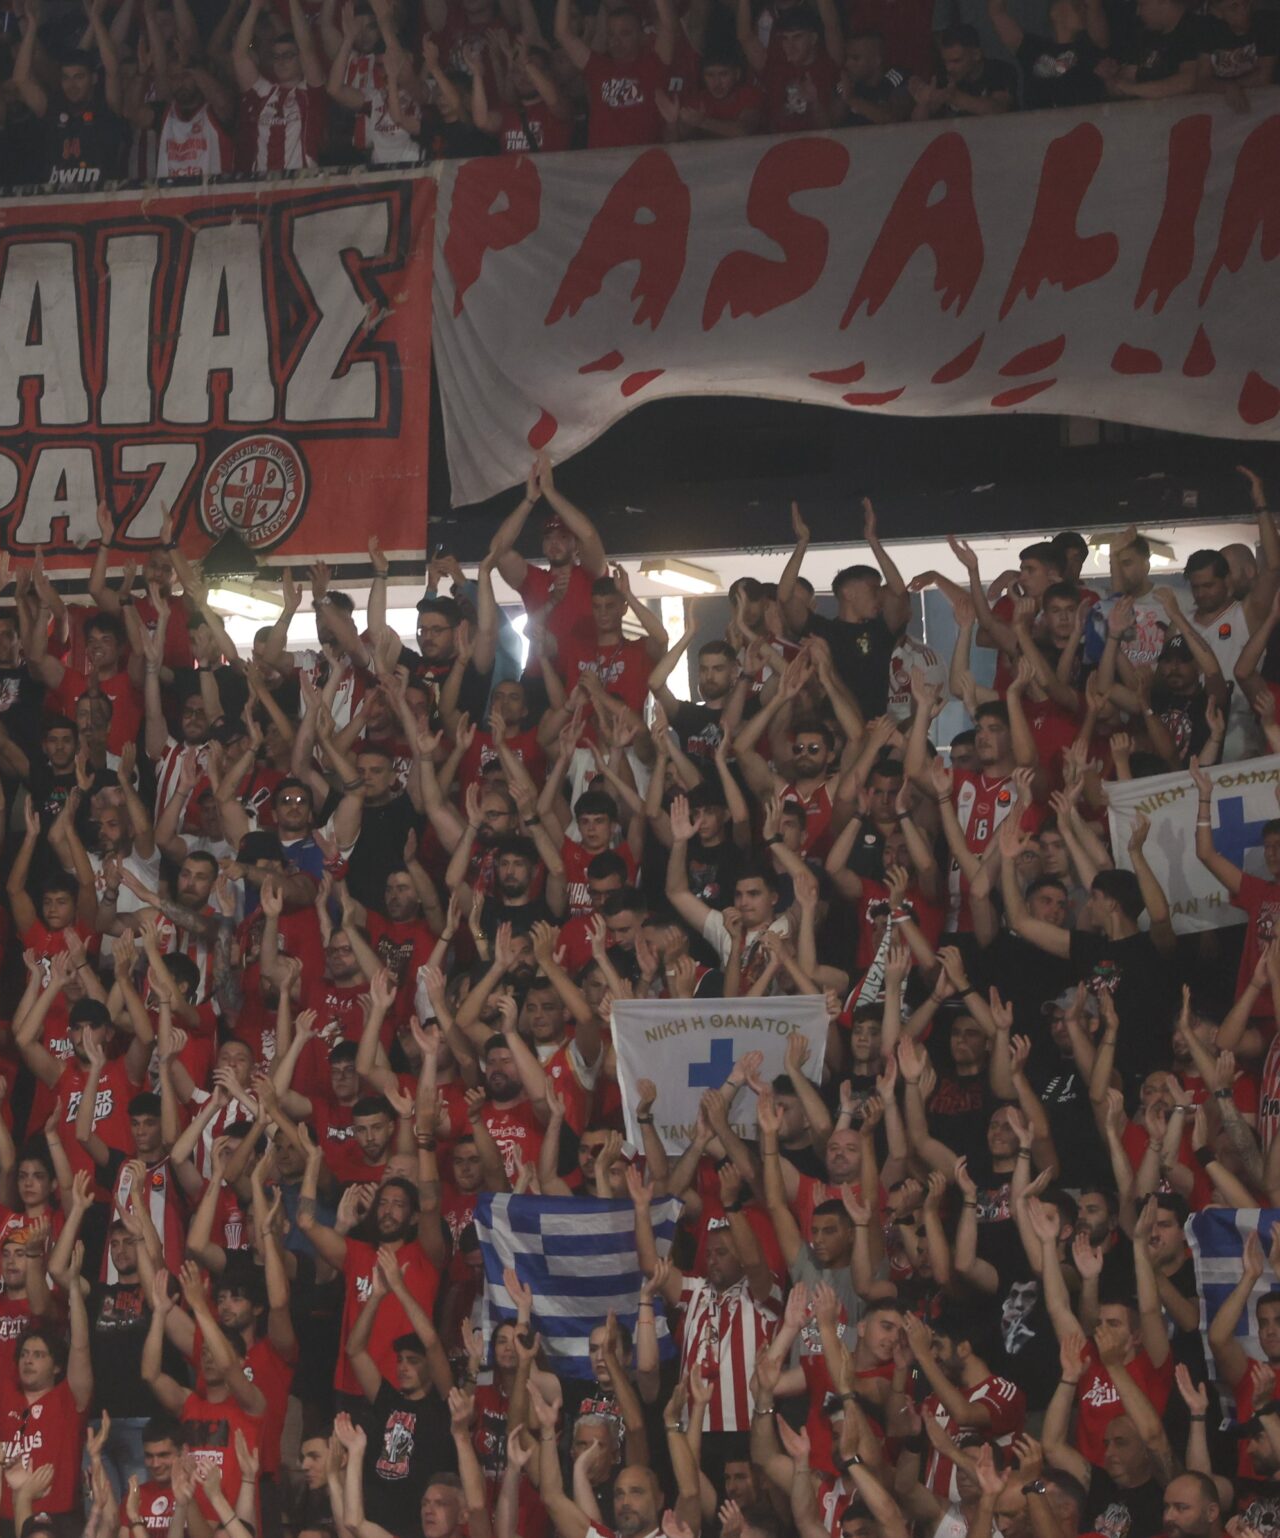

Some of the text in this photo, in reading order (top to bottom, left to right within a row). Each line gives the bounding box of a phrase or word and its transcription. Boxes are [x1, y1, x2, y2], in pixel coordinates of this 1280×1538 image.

[46, 161, 99, 185] bwin
[120, 441, 201, 541] 7
[973, 818, 987, 841] 16
[646, 1018, 688, 1043] ΝΙΚΗ
[691, 1015, 705, 1031] Η
